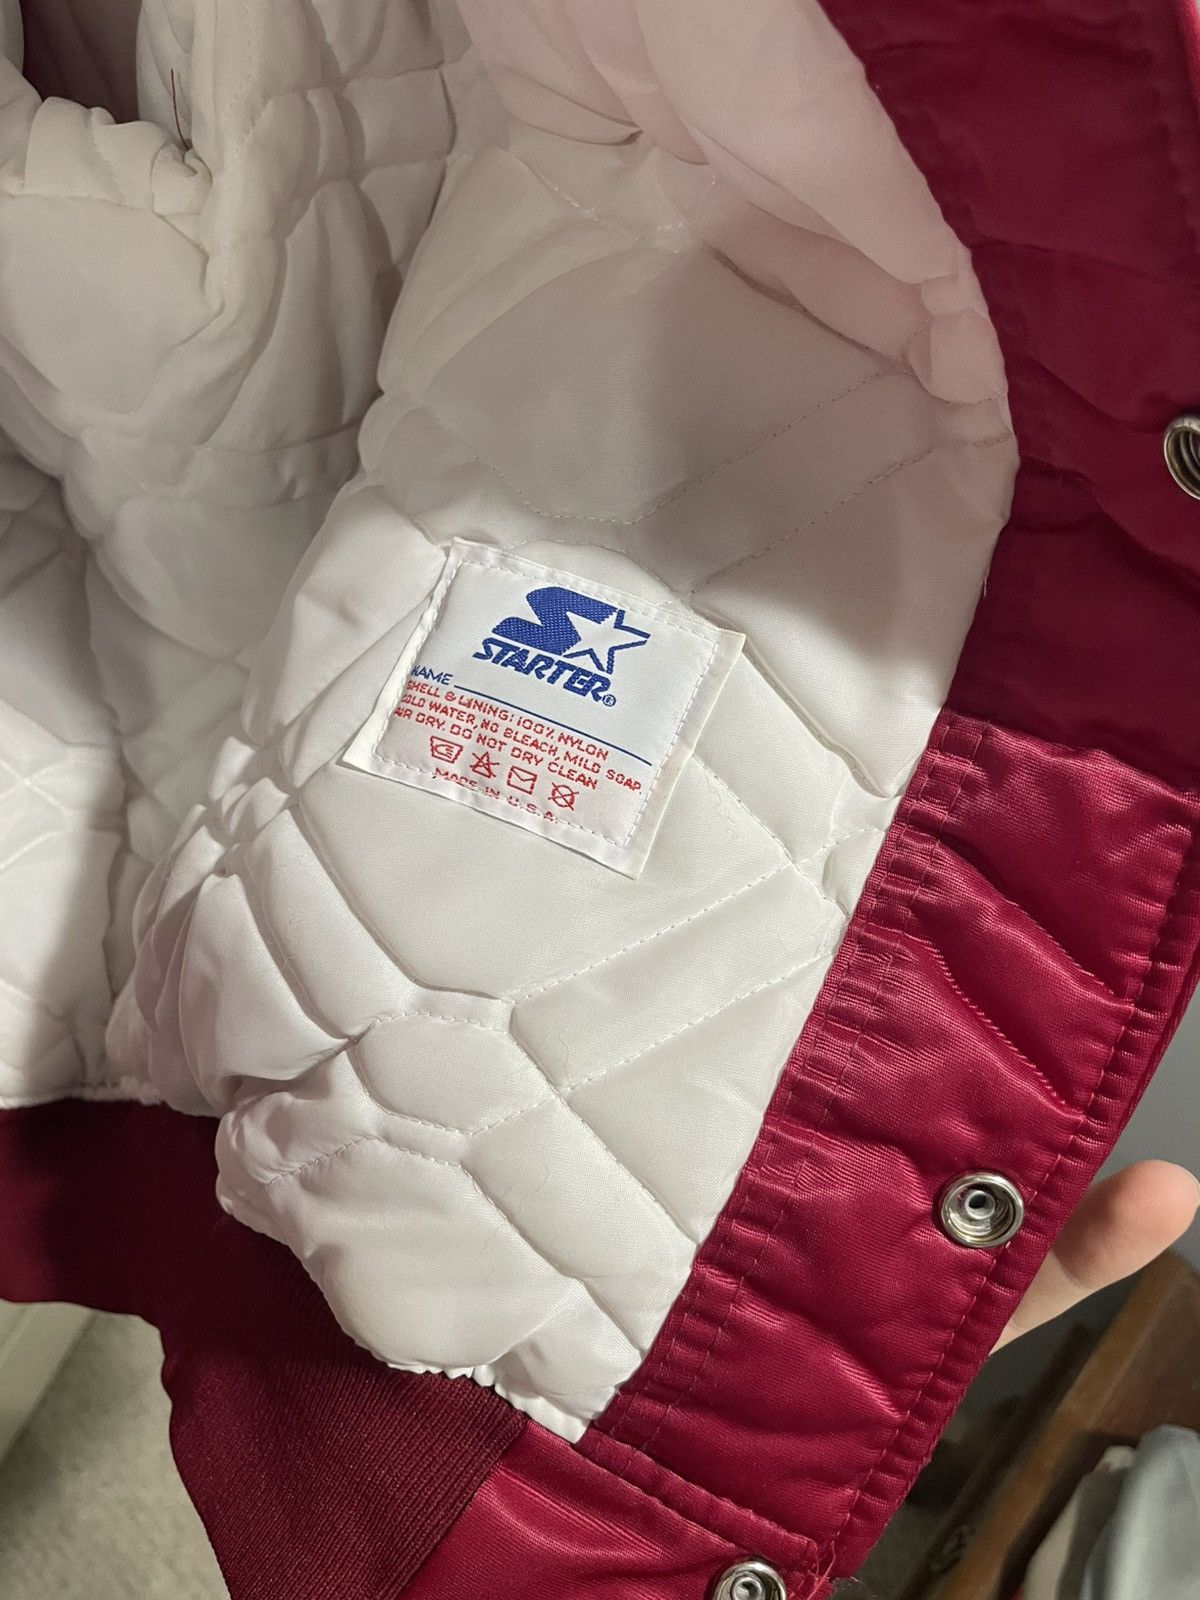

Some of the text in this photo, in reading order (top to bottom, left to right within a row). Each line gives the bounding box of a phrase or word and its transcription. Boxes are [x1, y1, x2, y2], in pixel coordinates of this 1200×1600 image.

[411, 665, 453, 685] NAME
[394, 706, 413, 720] AIR
[450, 723, 473, 740] DO
[476, 733, 507, 752] NOT
[510, 746, 544, 766] DRY
[547, 761, 598, 790] CLEAN
[406, 680, 609, 761] SHELL & LINING: 100% NYLON
[480, 718, 499, 733] NO
[503, 727, 560, 761] BLEACH,
[563, 751, 602, 775] MILD
[606, 769, 643, 795] SOAP.
[434, 767, 478, 792] MADE
[484, 786, 500, 800] IN
